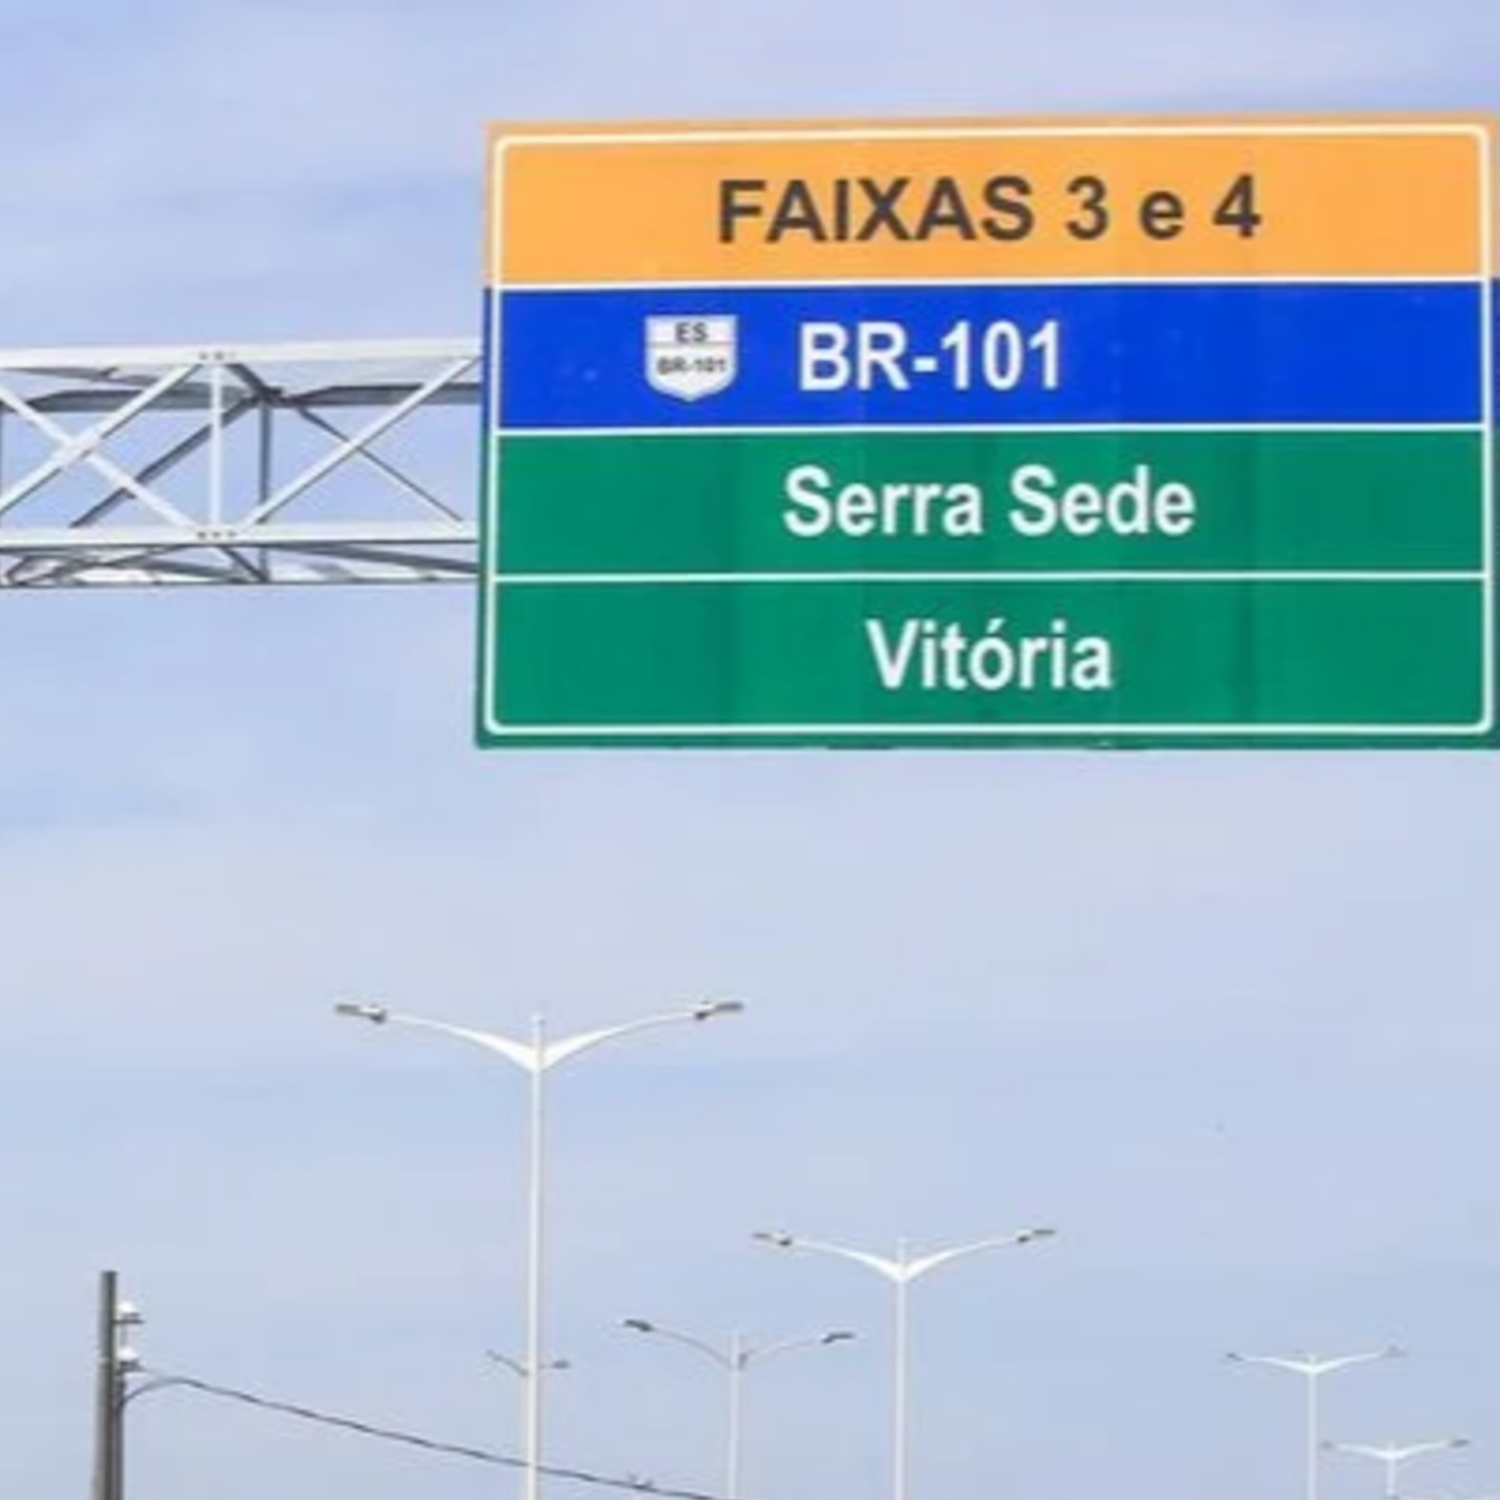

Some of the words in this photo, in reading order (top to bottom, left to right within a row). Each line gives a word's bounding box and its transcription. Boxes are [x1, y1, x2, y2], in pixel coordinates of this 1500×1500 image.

[717, 174, 1036, 245] FAIXAS
[1066, 174, 1110, 242] 3
[1138, 189, 1185, 242] e
[1212, 173, 1263, 240] 4
[675, 322, 707, 343] ES
[798, 320, 1061, 393] BR-101
[783, 463, 984, 538] Serra
[1009, 462, 1197, 537] Sede
[865, 616, 1114, 692] Vitória
